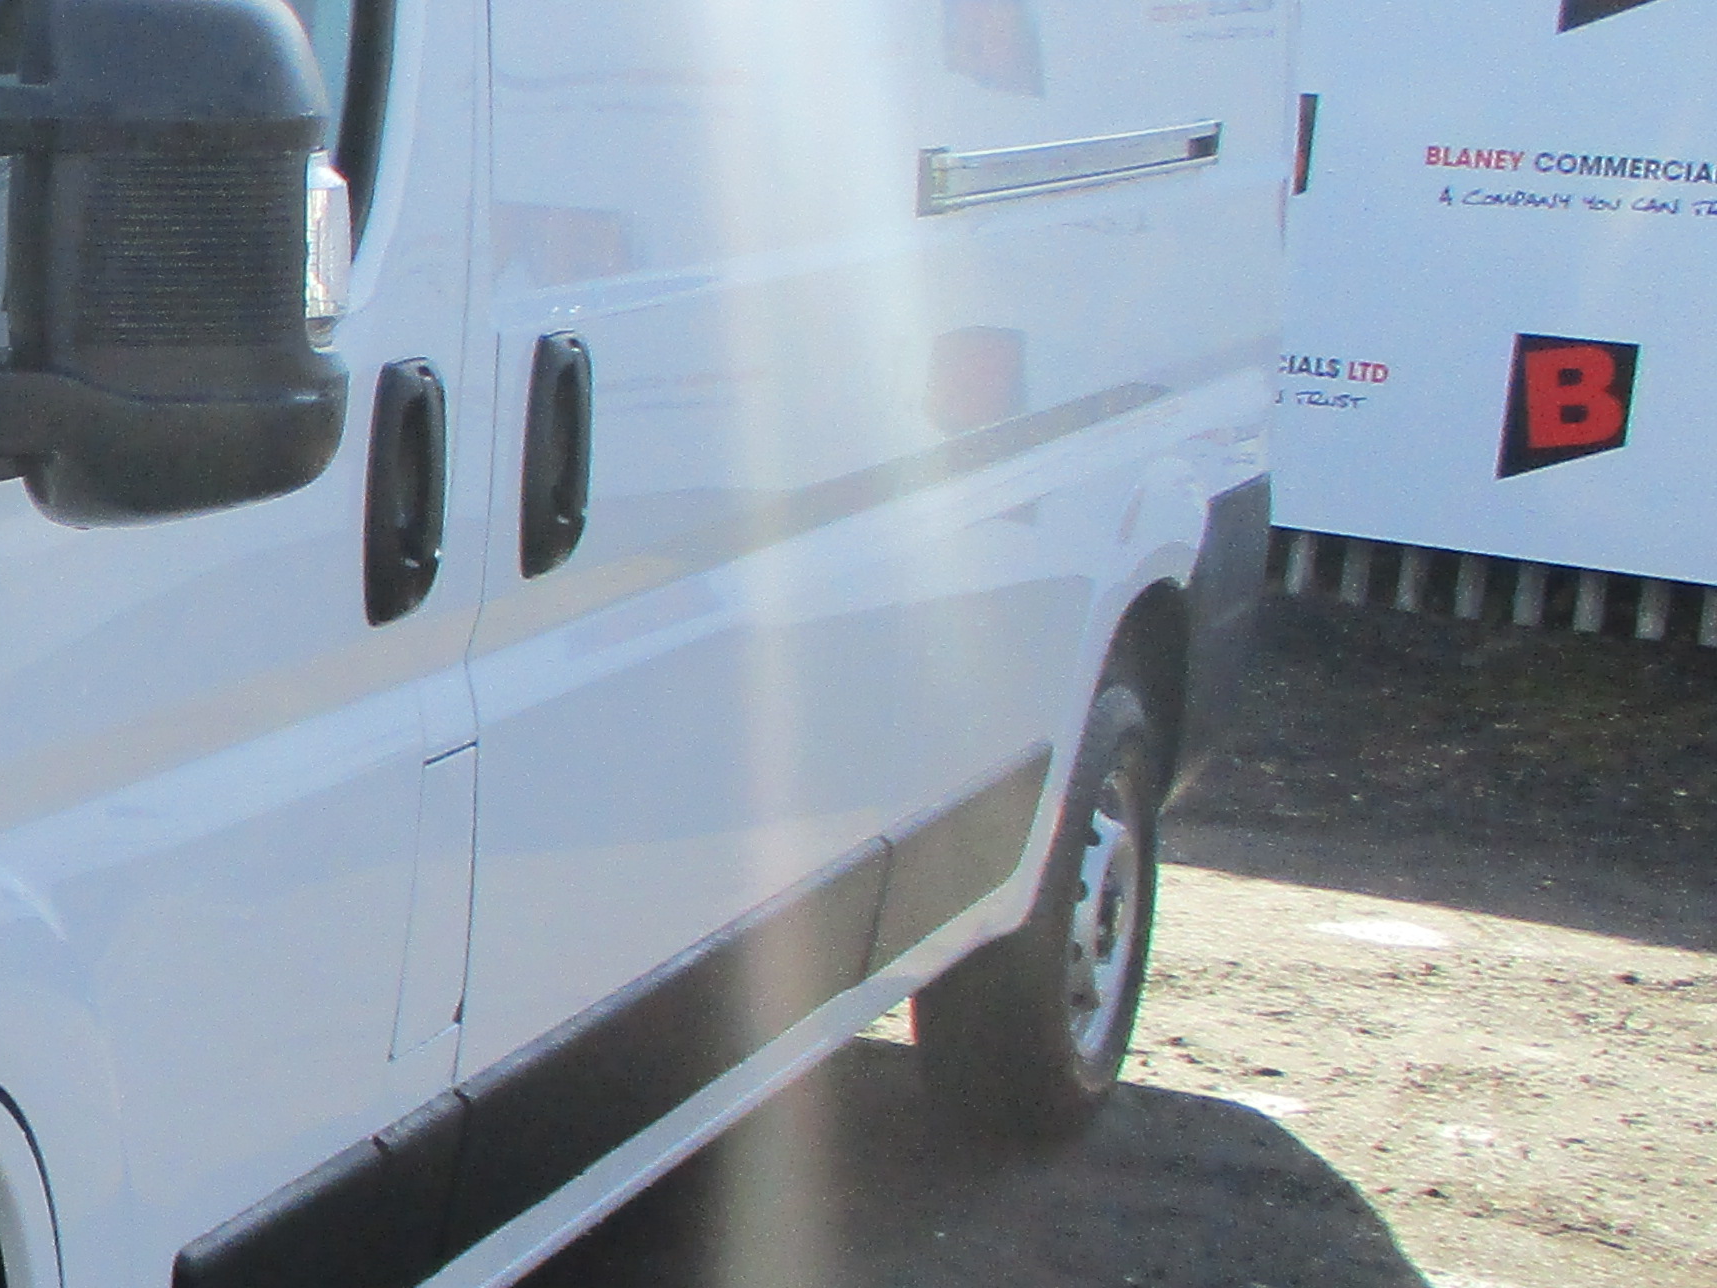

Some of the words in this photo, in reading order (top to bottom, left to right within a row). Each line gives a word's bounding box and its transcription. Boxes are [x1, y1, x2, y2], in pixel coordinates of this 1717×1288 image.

[1425, 146, 1525, 170] BLANEY
[1533, 152, 1717, 183] COMMERCIA
[1462, 188, 1571, 209] COMPANY
[1630, 197, 1679, 214] CAN
[1347, 361, 1390, 383] LTD
[1295, 391, 1367, 408] TRUST
[1525, 345, 1625, 449] B
